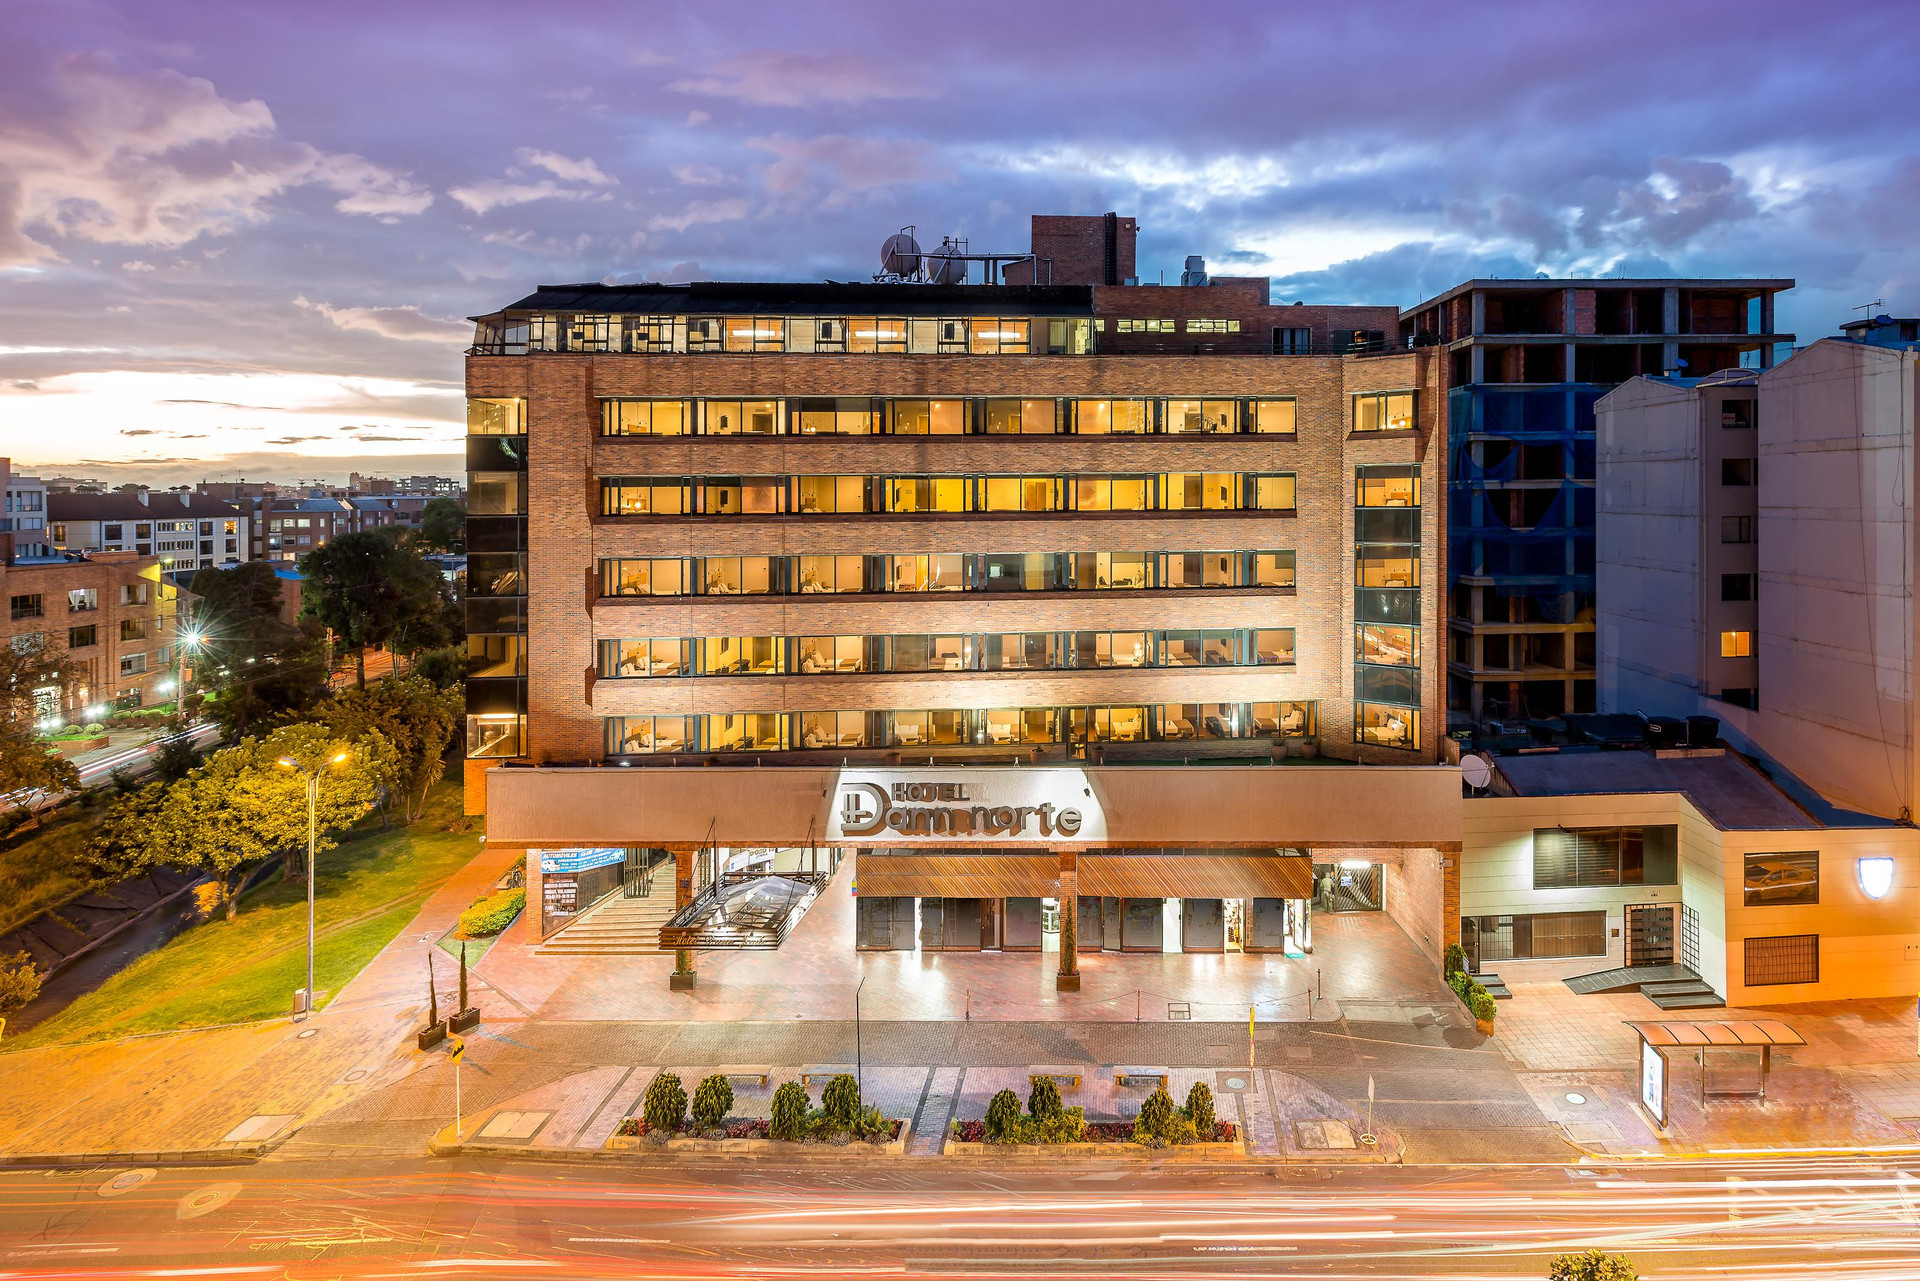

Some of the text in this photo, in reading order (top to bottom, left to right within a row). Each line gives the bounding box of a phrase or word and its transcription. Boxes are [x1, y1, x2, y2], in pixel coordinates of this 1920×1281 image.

[841, 783, 1082, 831] Dann norte
[892, 783, 969, 801] HOTEL
